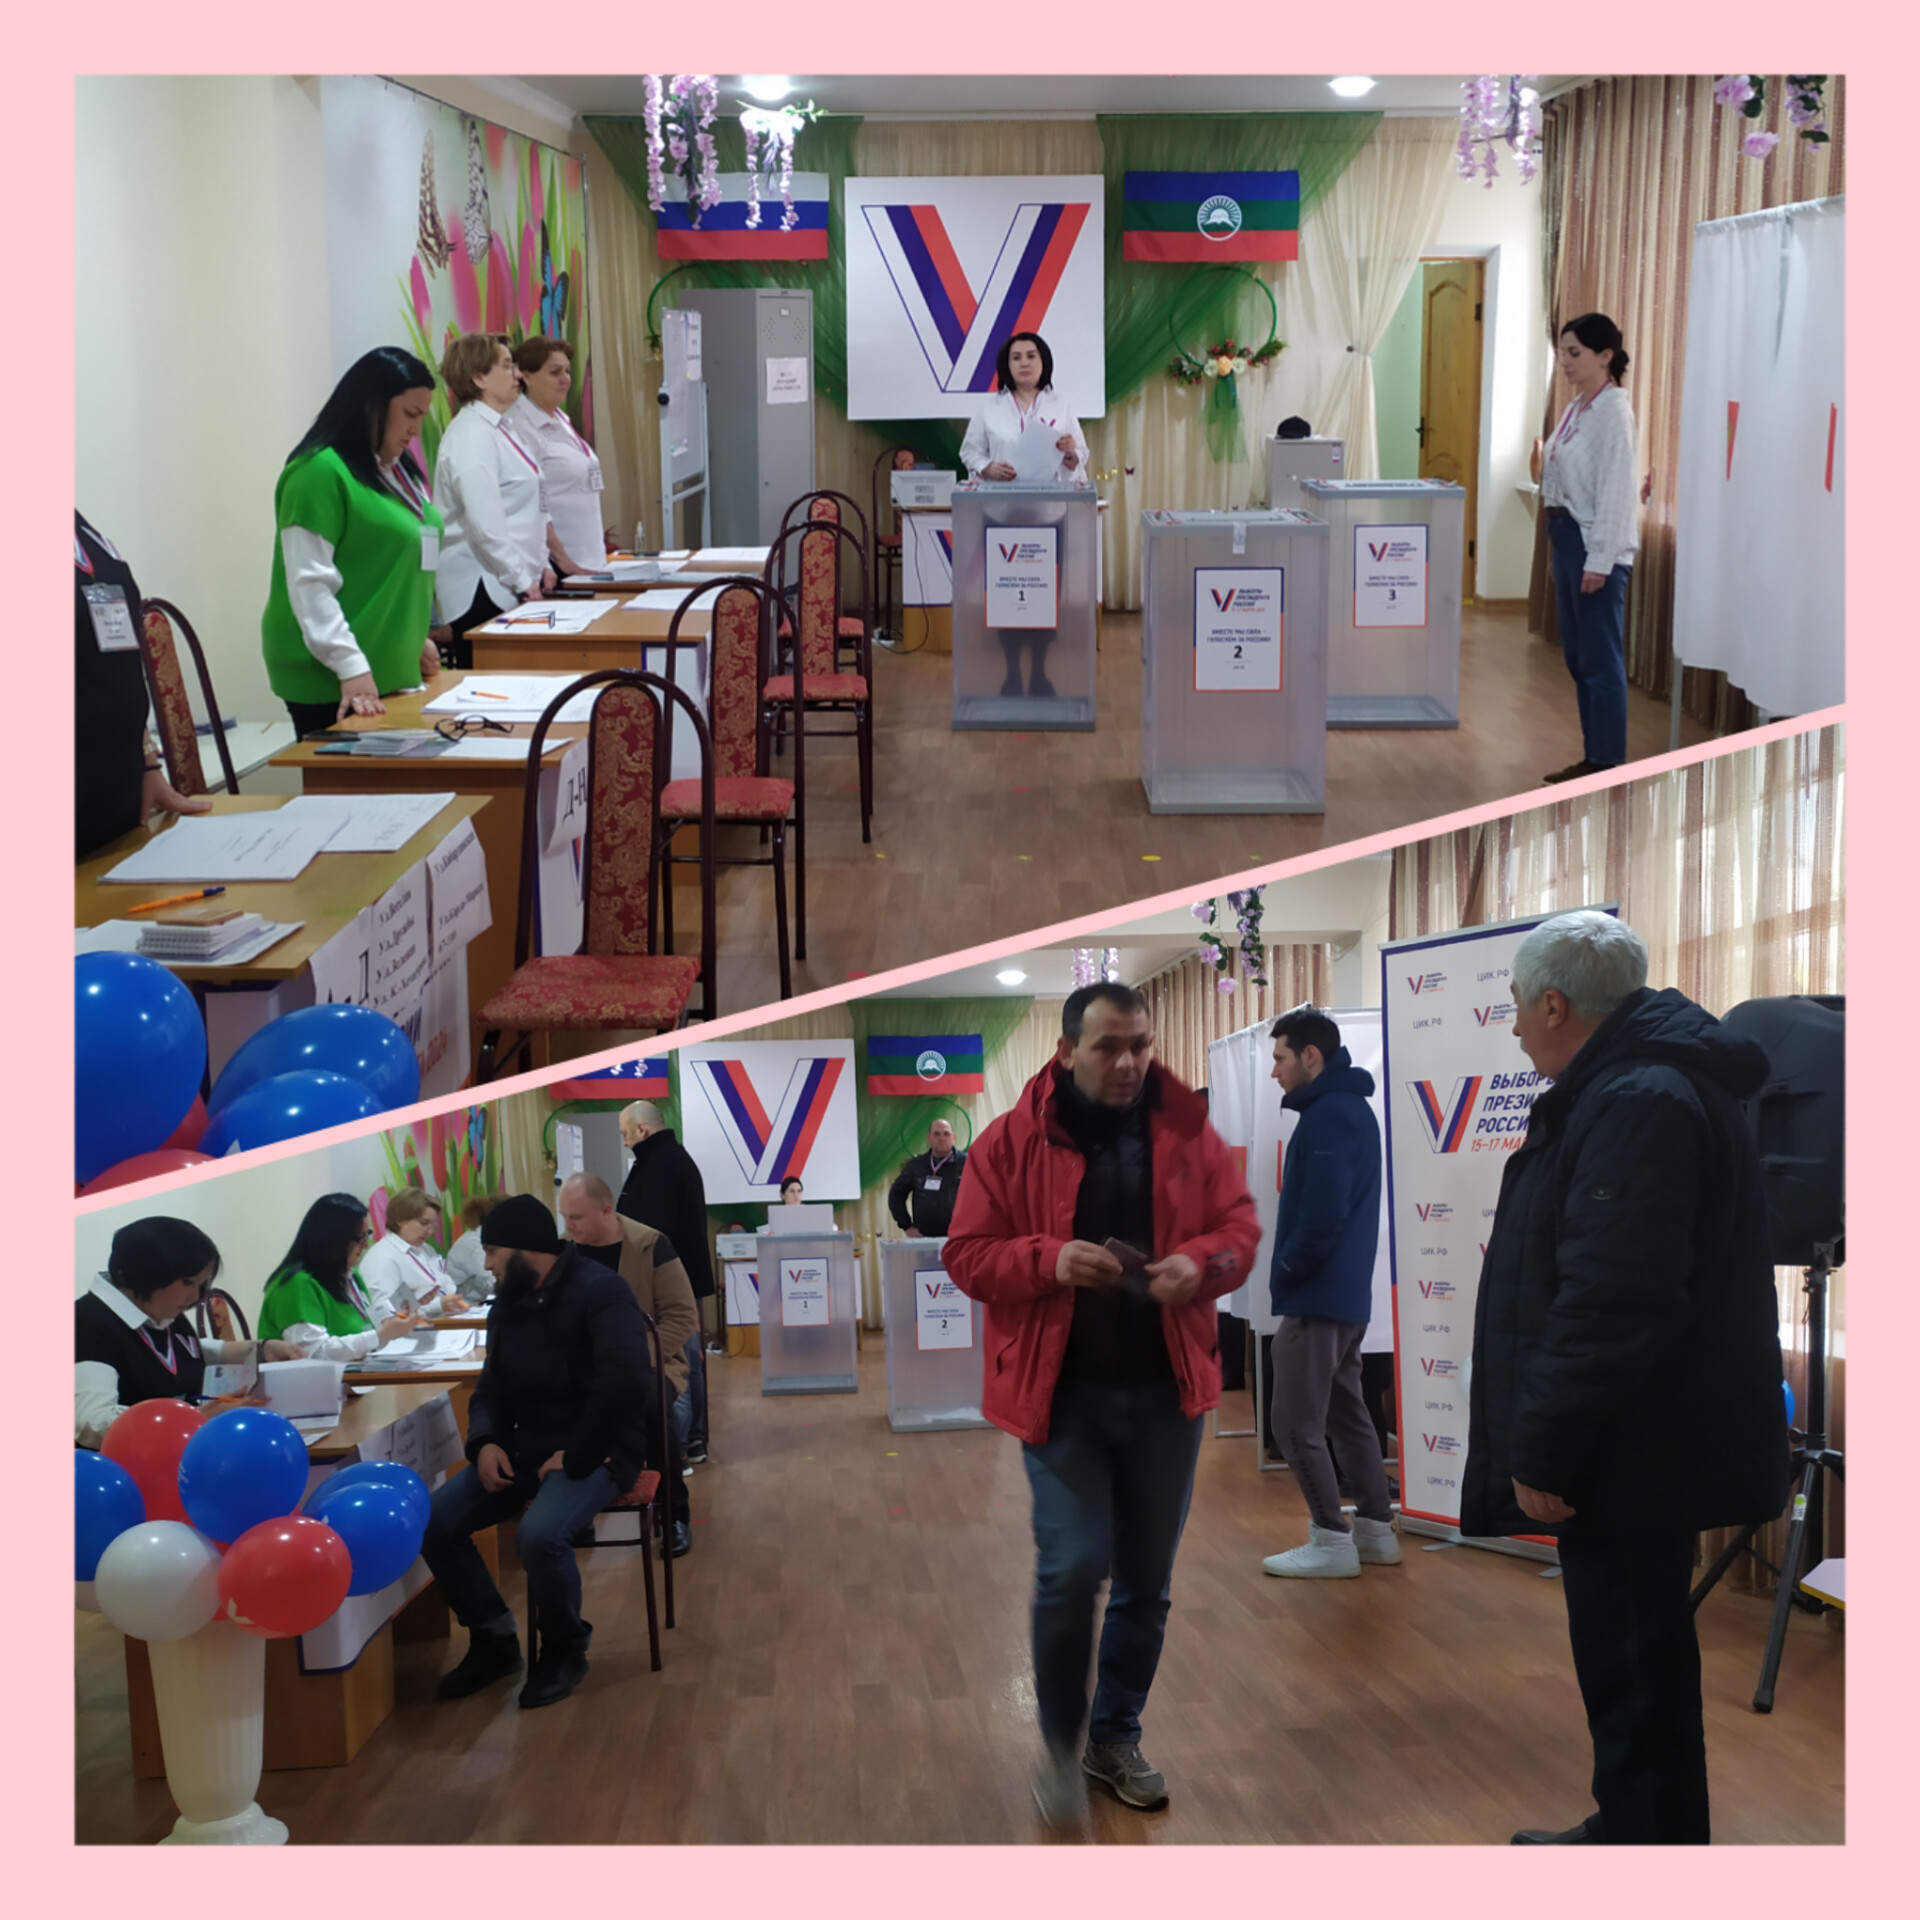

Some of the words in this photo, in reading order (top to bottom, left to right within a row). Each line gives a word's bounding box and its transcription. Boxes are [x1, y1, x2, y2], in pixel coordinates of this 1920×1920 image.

[1018, 590, 1025, 601] 1
[1388, 589, 1396, 601] 3
[1233, 645, 1243, 659] 2
[1483, 1092, 1545, 1112] ПРЕЗИ
[1475, 1115, 1530, 1134] РОССИ
[1501, 1136, 1527, 1151] МА
[941, 1319, 948, 1329] 2
